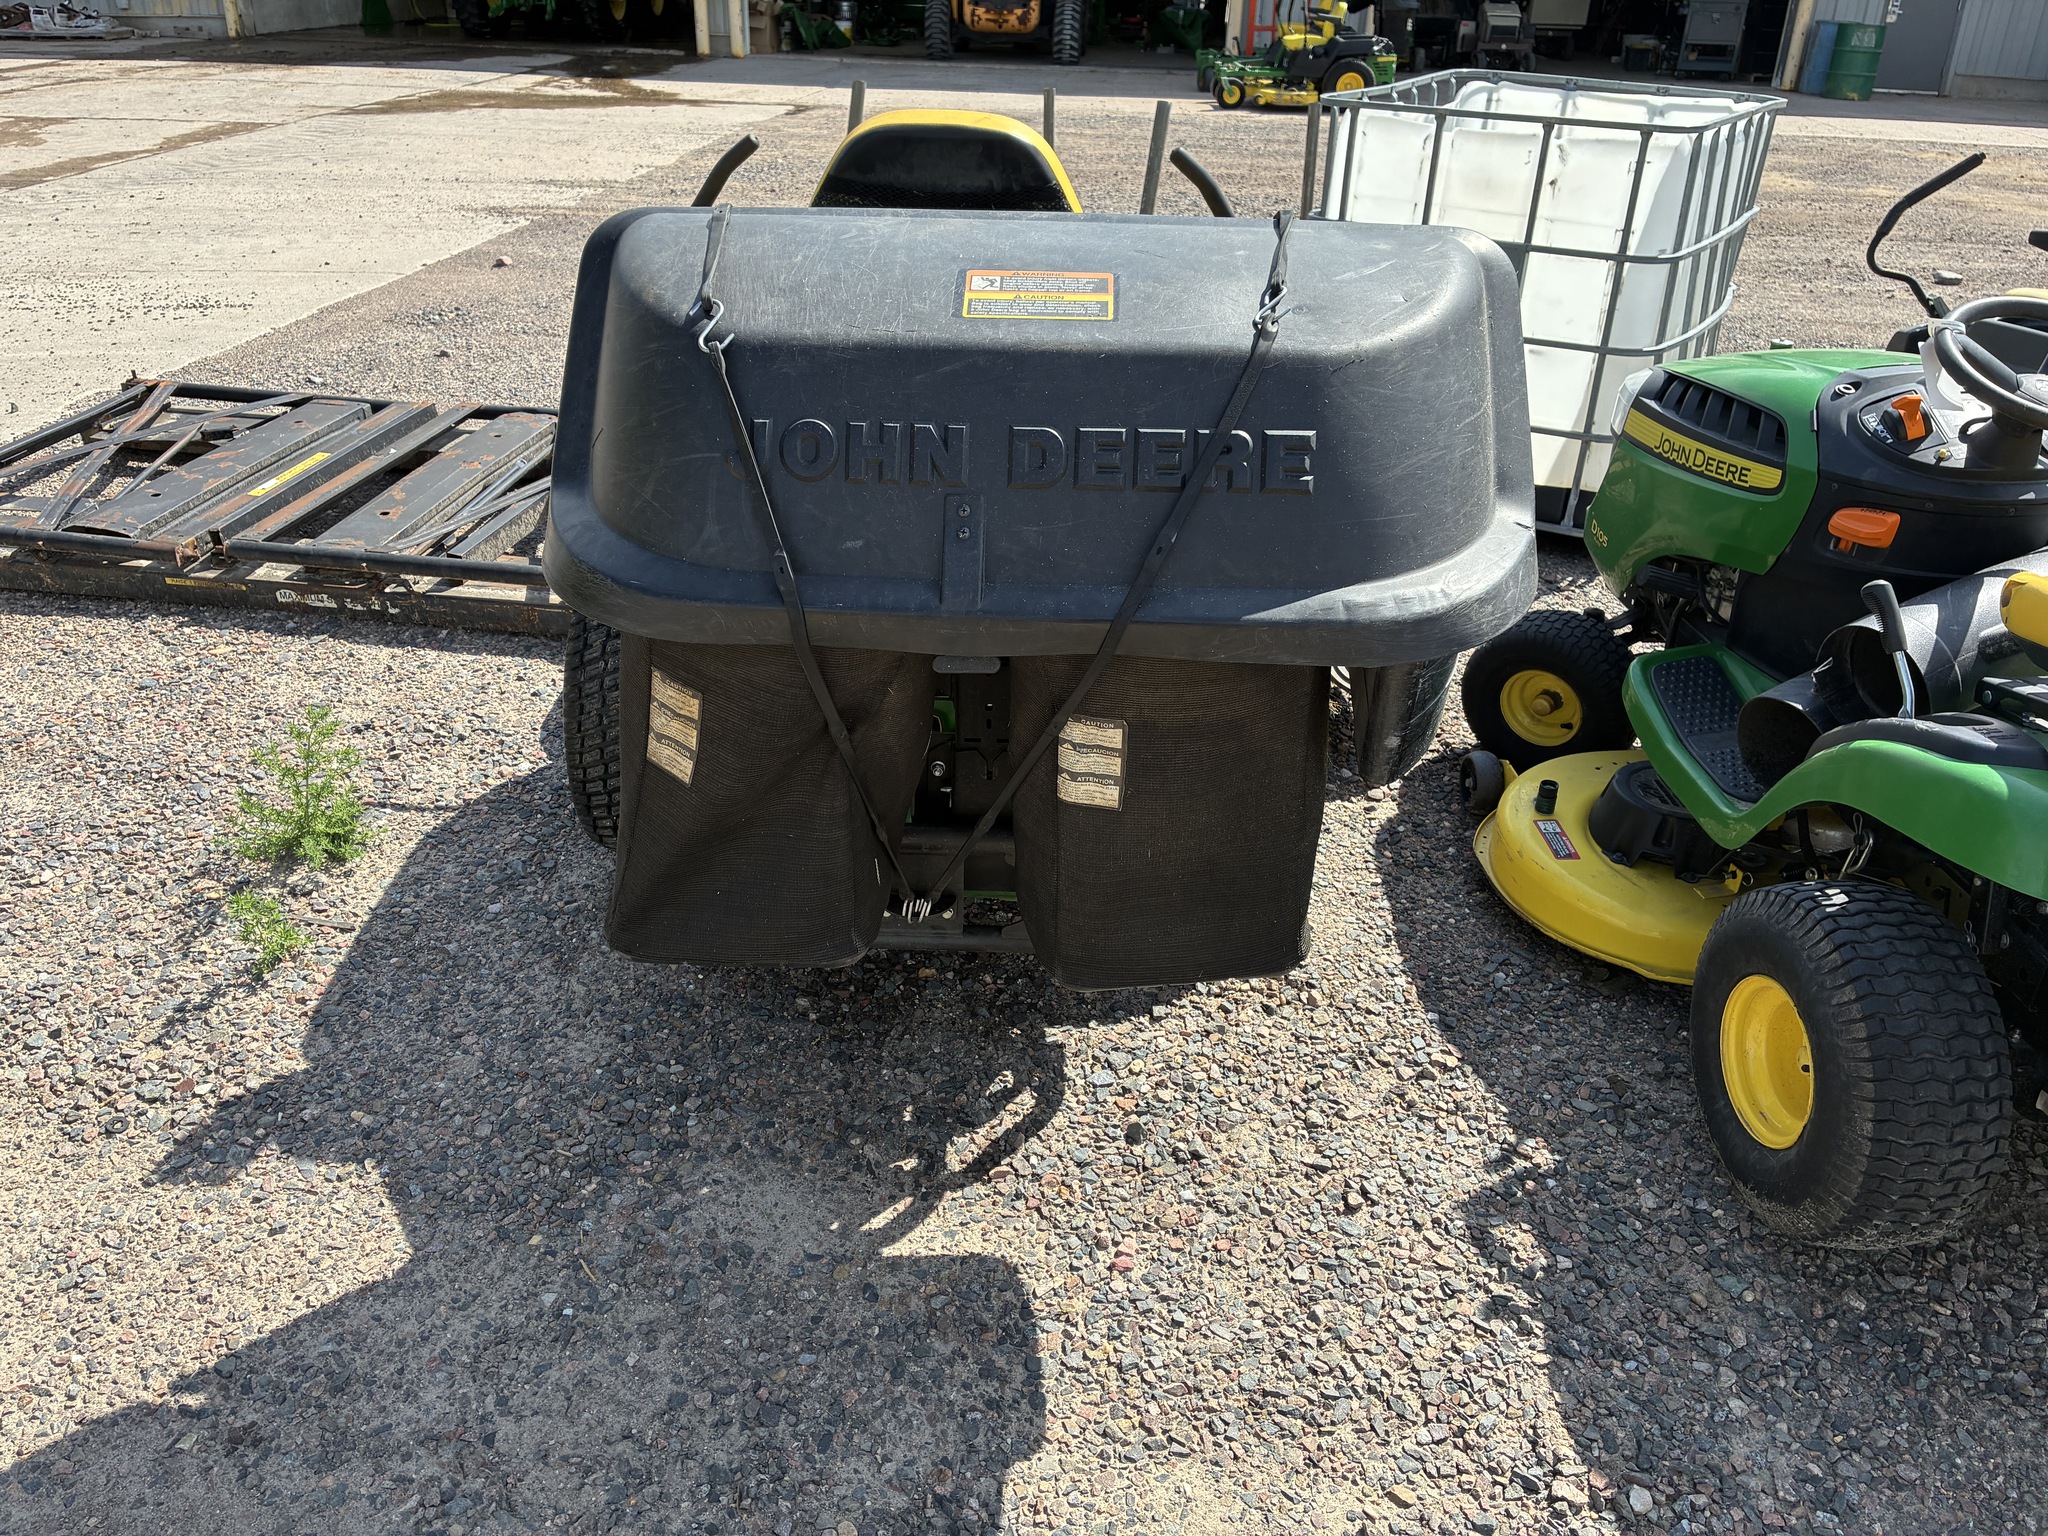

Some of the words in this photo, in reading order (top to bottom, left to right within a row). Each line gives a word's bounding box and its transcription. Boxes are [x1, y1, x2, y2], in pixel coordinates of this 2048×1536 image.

[724, 417, 970, 488] JOHN
[1007, 425, 1318, 495] DEERE
[1653, 432, 1692, 465] JOHN
[1693, 449, 1751, 484] DEERE
[1591, 519, 1609, 547] D105
[279, 591, 325, 603] MAXIMUM
[666, 680, 693, 696] CAUTION
[1081, 719, 1114, 728] CAUTION
[661, 739, 691, 758] ATTENTION
[1077, 776, 1114, 785] ATTENTION
